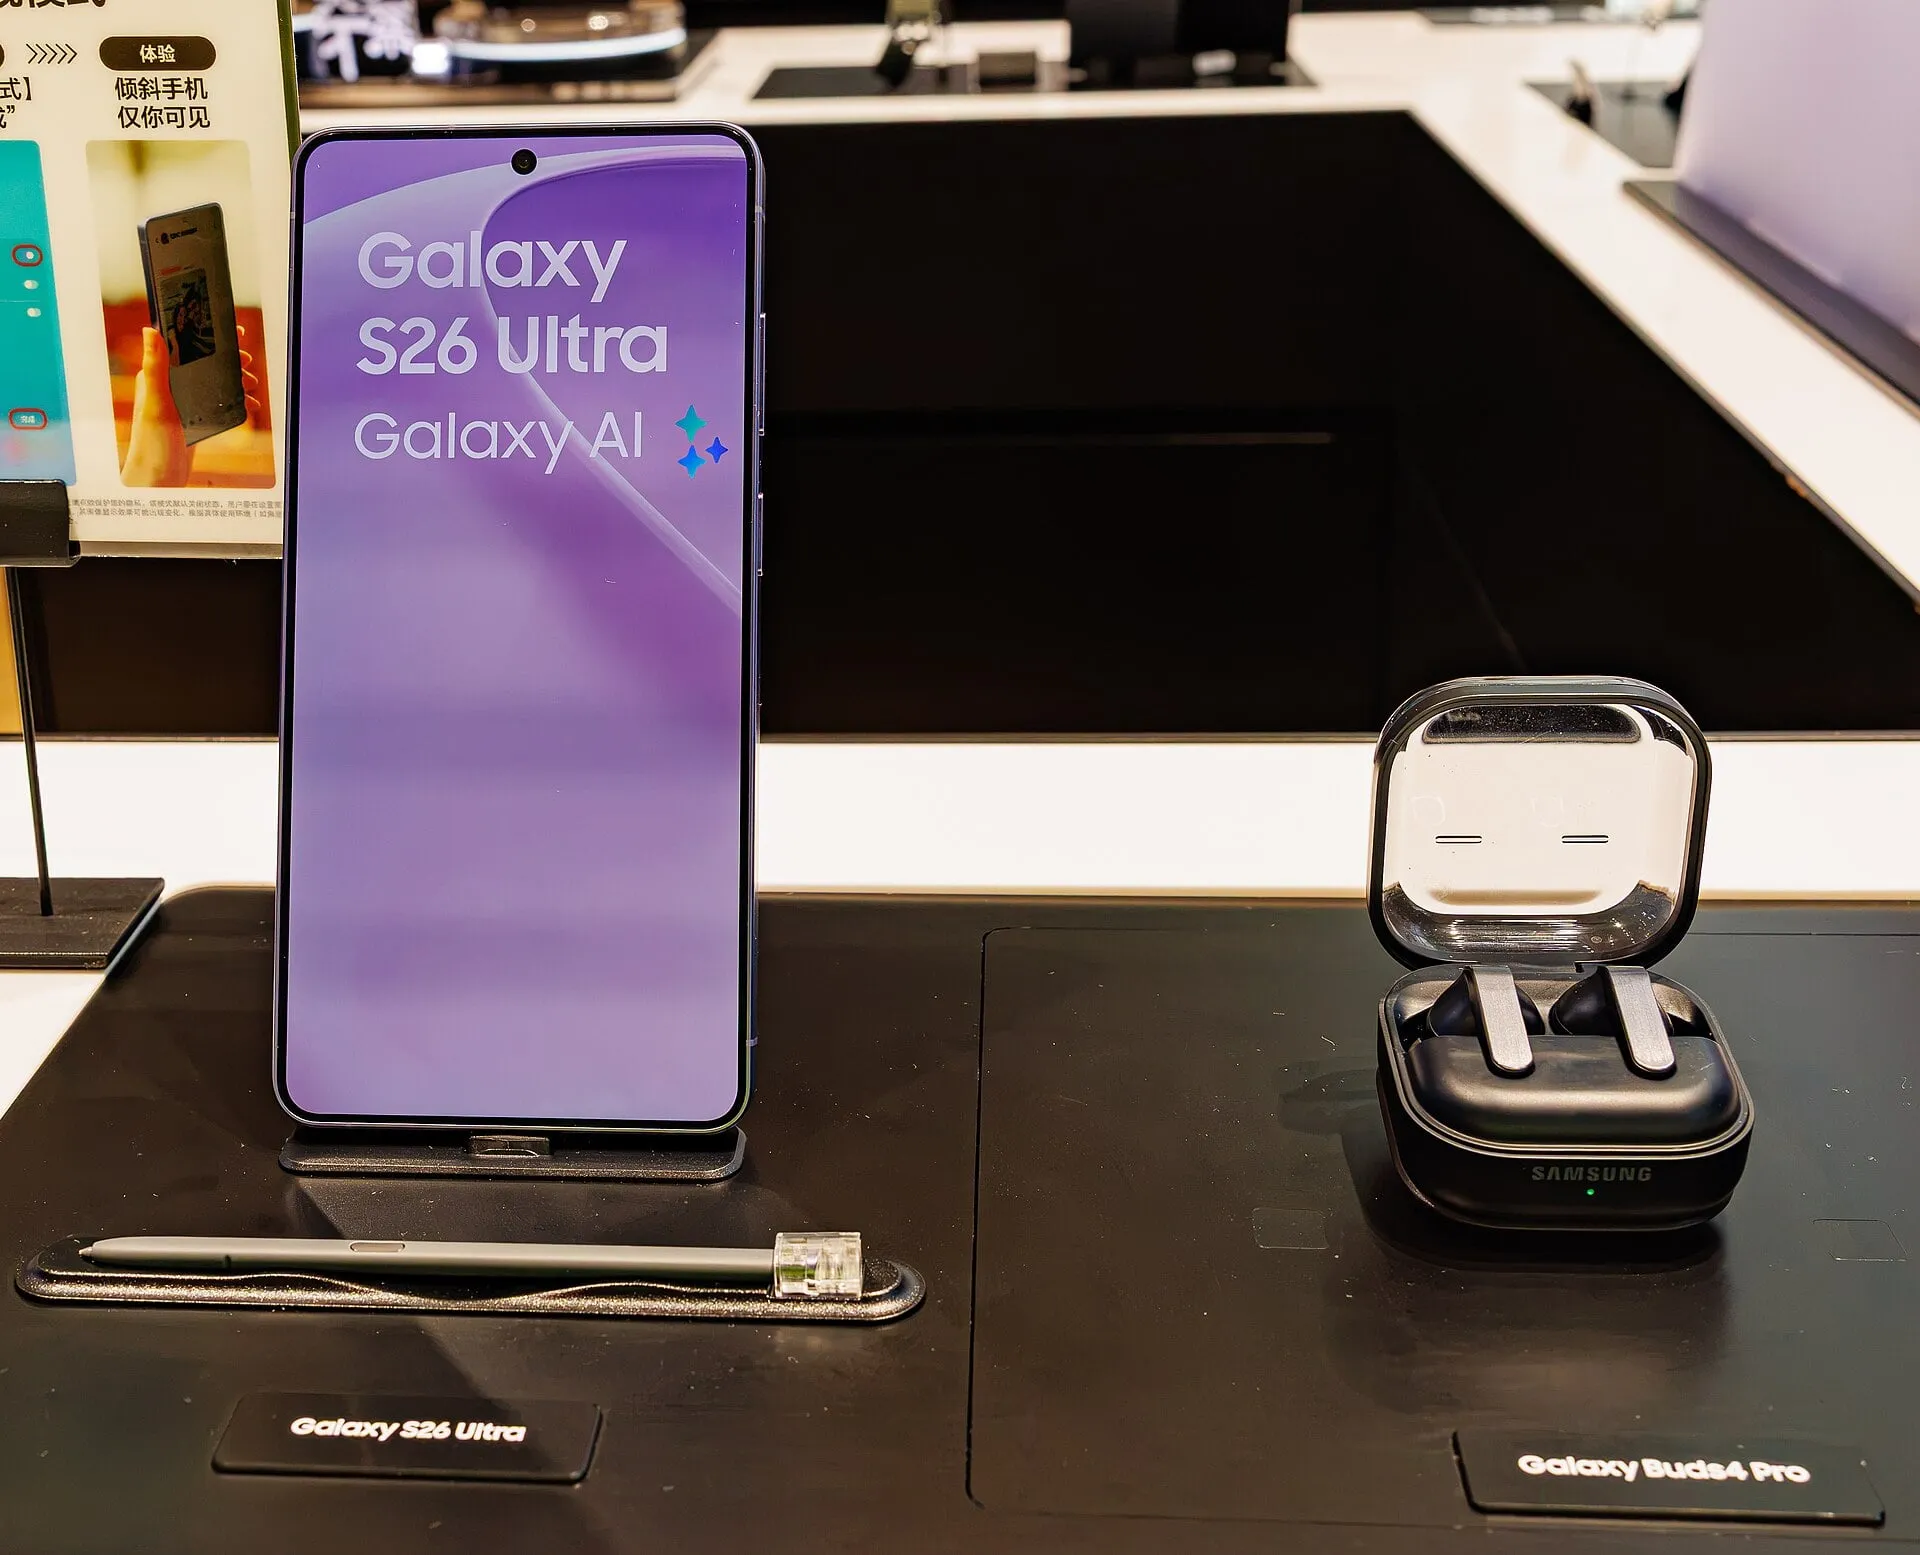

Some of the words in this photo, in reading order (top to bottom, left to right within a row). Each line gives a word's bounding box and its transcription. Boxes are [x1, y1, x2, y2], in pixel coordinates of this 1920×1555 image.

[139, 44, 176, 64] 体验
[114, 76, 209, 101] 倾斜手机
[117, 105, 211, 129] 仅你可见
[357, 230, 628, 303] Galaxy
[355, 317, 478, 375] S26
[497, 314, 668, 374] Ultra
[354, 412, 574, 475] Galaxy
[589, 411, 643, 458] AI
[1531, 1166, 1652, 1182] SAMSUNG
[290, 1417, 400, 1442] Galaxy
[400, 1420, 451, 1440] S26
[455, 1421, 527, 1442] Ultra
[1518, 1454, 1639, 1482] Galaxy
[1641, 1458, 1749, 1481] Buds4
[1749, 1461, 1811, 1483] Pro
